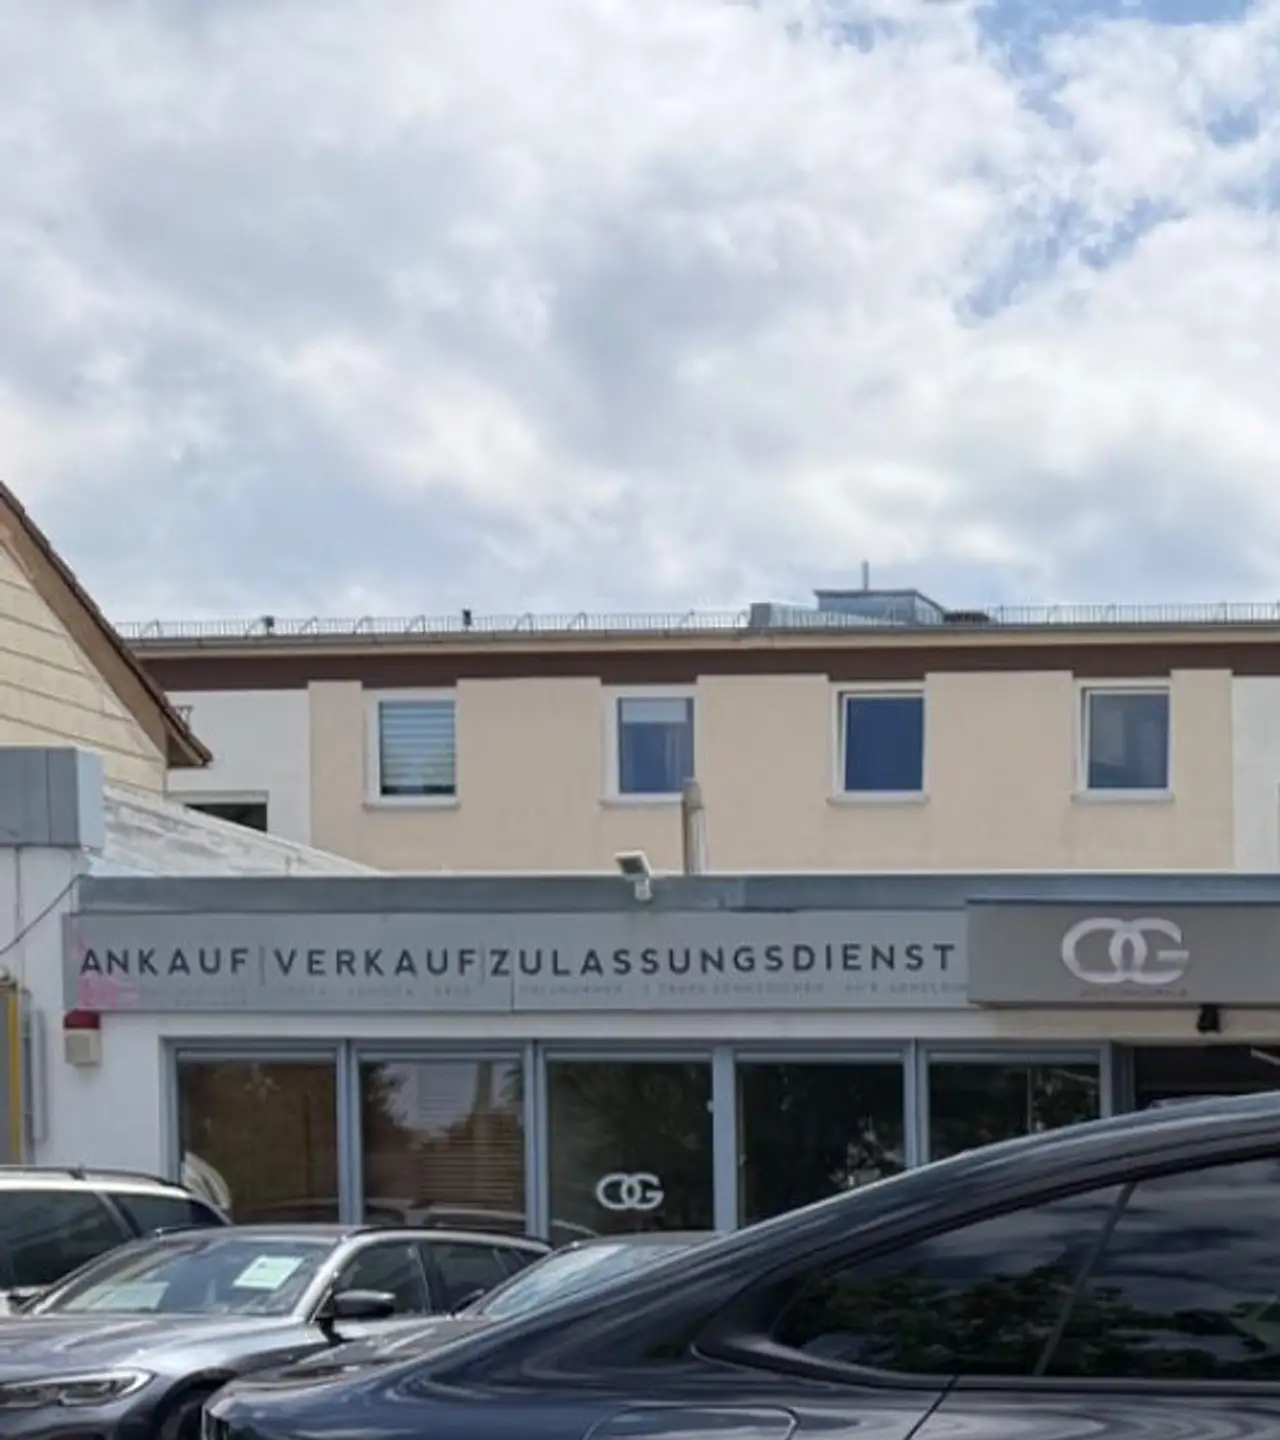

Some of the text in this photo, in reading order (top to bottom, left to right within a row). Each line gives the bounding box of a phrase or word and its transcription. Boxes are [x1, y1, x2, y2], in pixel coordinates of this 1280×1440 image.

[80, 943, 956, 977] ANKAUF VERKAUF ZULASSUNGSDIENST
